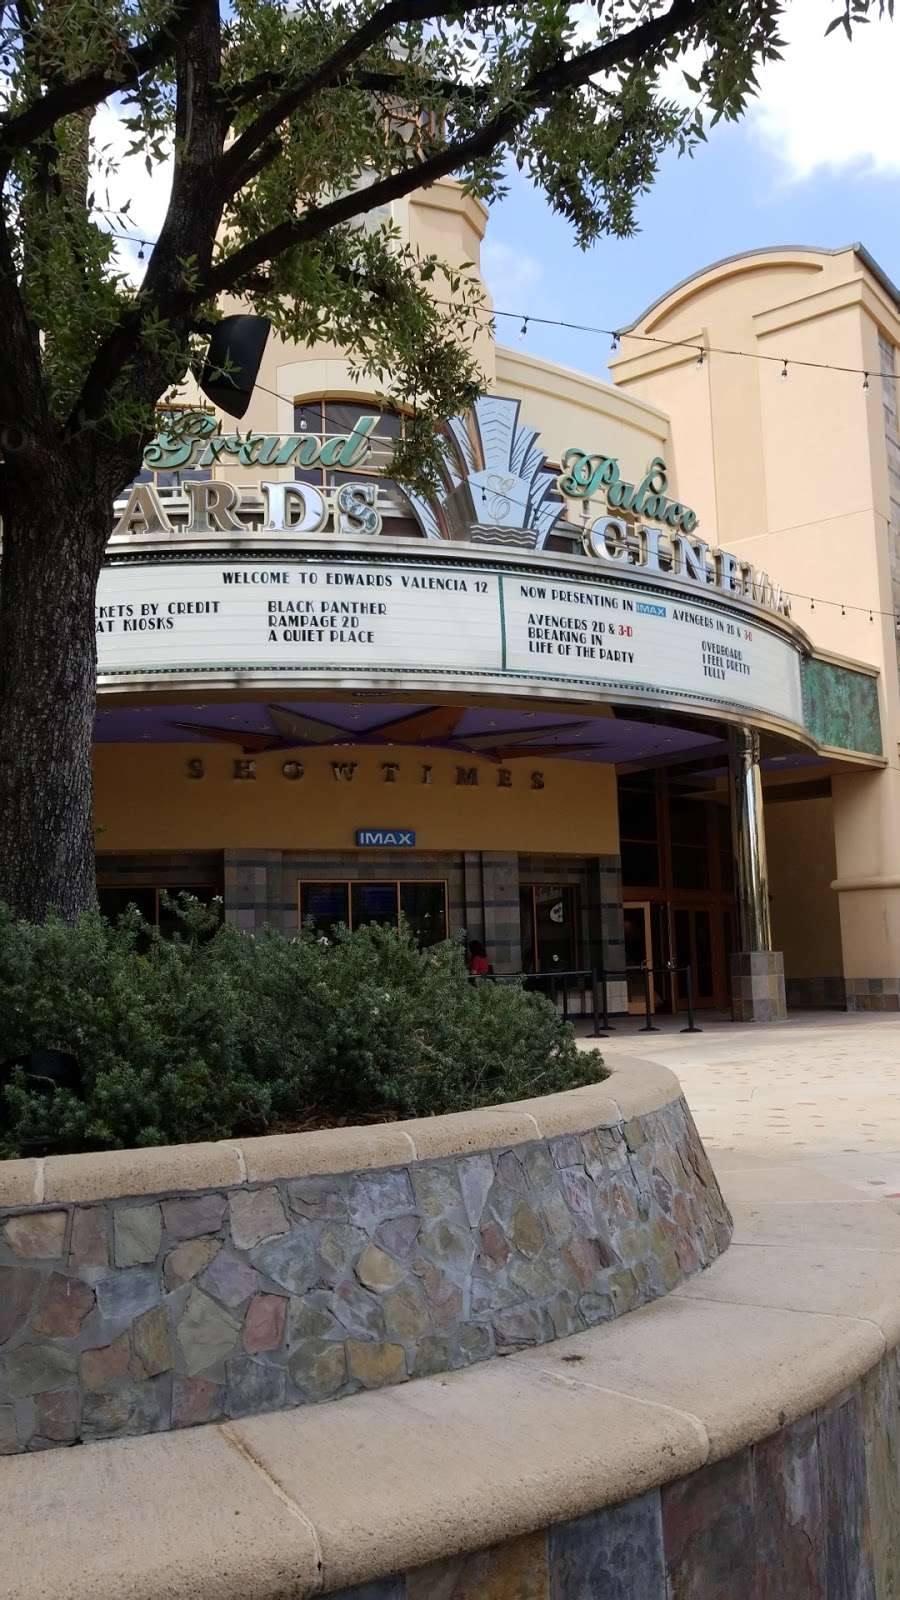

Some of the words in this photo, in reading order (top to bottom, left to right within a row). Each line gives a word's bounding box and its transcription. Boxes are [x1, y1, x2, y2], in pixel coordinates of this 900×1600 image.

[143, 410, 382, 470] Grand
[556, 447, 700, 534] Palace
[222, 571, 290, 585] WELCOME
[300, 571, 318, 585] TO
[326, 573, 393, 587] EDWARDS
[401, 575, 468, 592] VALENCIA
[474, 581, 489, 593] 12
[141, 603, 159, 616] BY
[167, 601, 221, 615] CREDIT
[267, 600, 315, 613] BLACK
[321, 601, 387, 616] PANTHER
[520, 585, 547, 599] NOW
[551, 589, 619, 610] PRESENTING
[622, 599, 634, 611] IN
[637, 602, 667, 617] IMAX
[96, 620, 116, 632] AT
[123, 617, 175, 632] KIOSKS
[268, 615, 338, 628] RAMPAGE
[342, 616, 360, 629] 2D
[528, 613, 588, 631] AVENGERS
[592, 621, 606, 634] 2D
[608, 623, 616, 635] &
[618, 624, 634, 637] 3-D
[672, 609, 714, 629] AVENGERS
[716, 620, 724, 633] IN
[268, 629, 278, 642] A
[283, 629, 325, 643] QUIET
[329, 630, 376, 644] PLACE
[528, 627, 587, 645] BREAKING
[591, 634, 603, 646] IN
[528, 640, 554, 654] LIFE
[558, 644, 573, 656] OF
[575, 645, 596, 659] THE
[599, 648, 635, 664] PARTY
[701, 640, 743, 661] OVERBOARD
[703, 665, 726, 680] TULLY
[707, 654, 724, 669] FEEL
[726, 659, 751, 676] PRETTY
[186, 758, 546, 790] SHOWTIMES
[359, 831, 413, 846] IMAX
